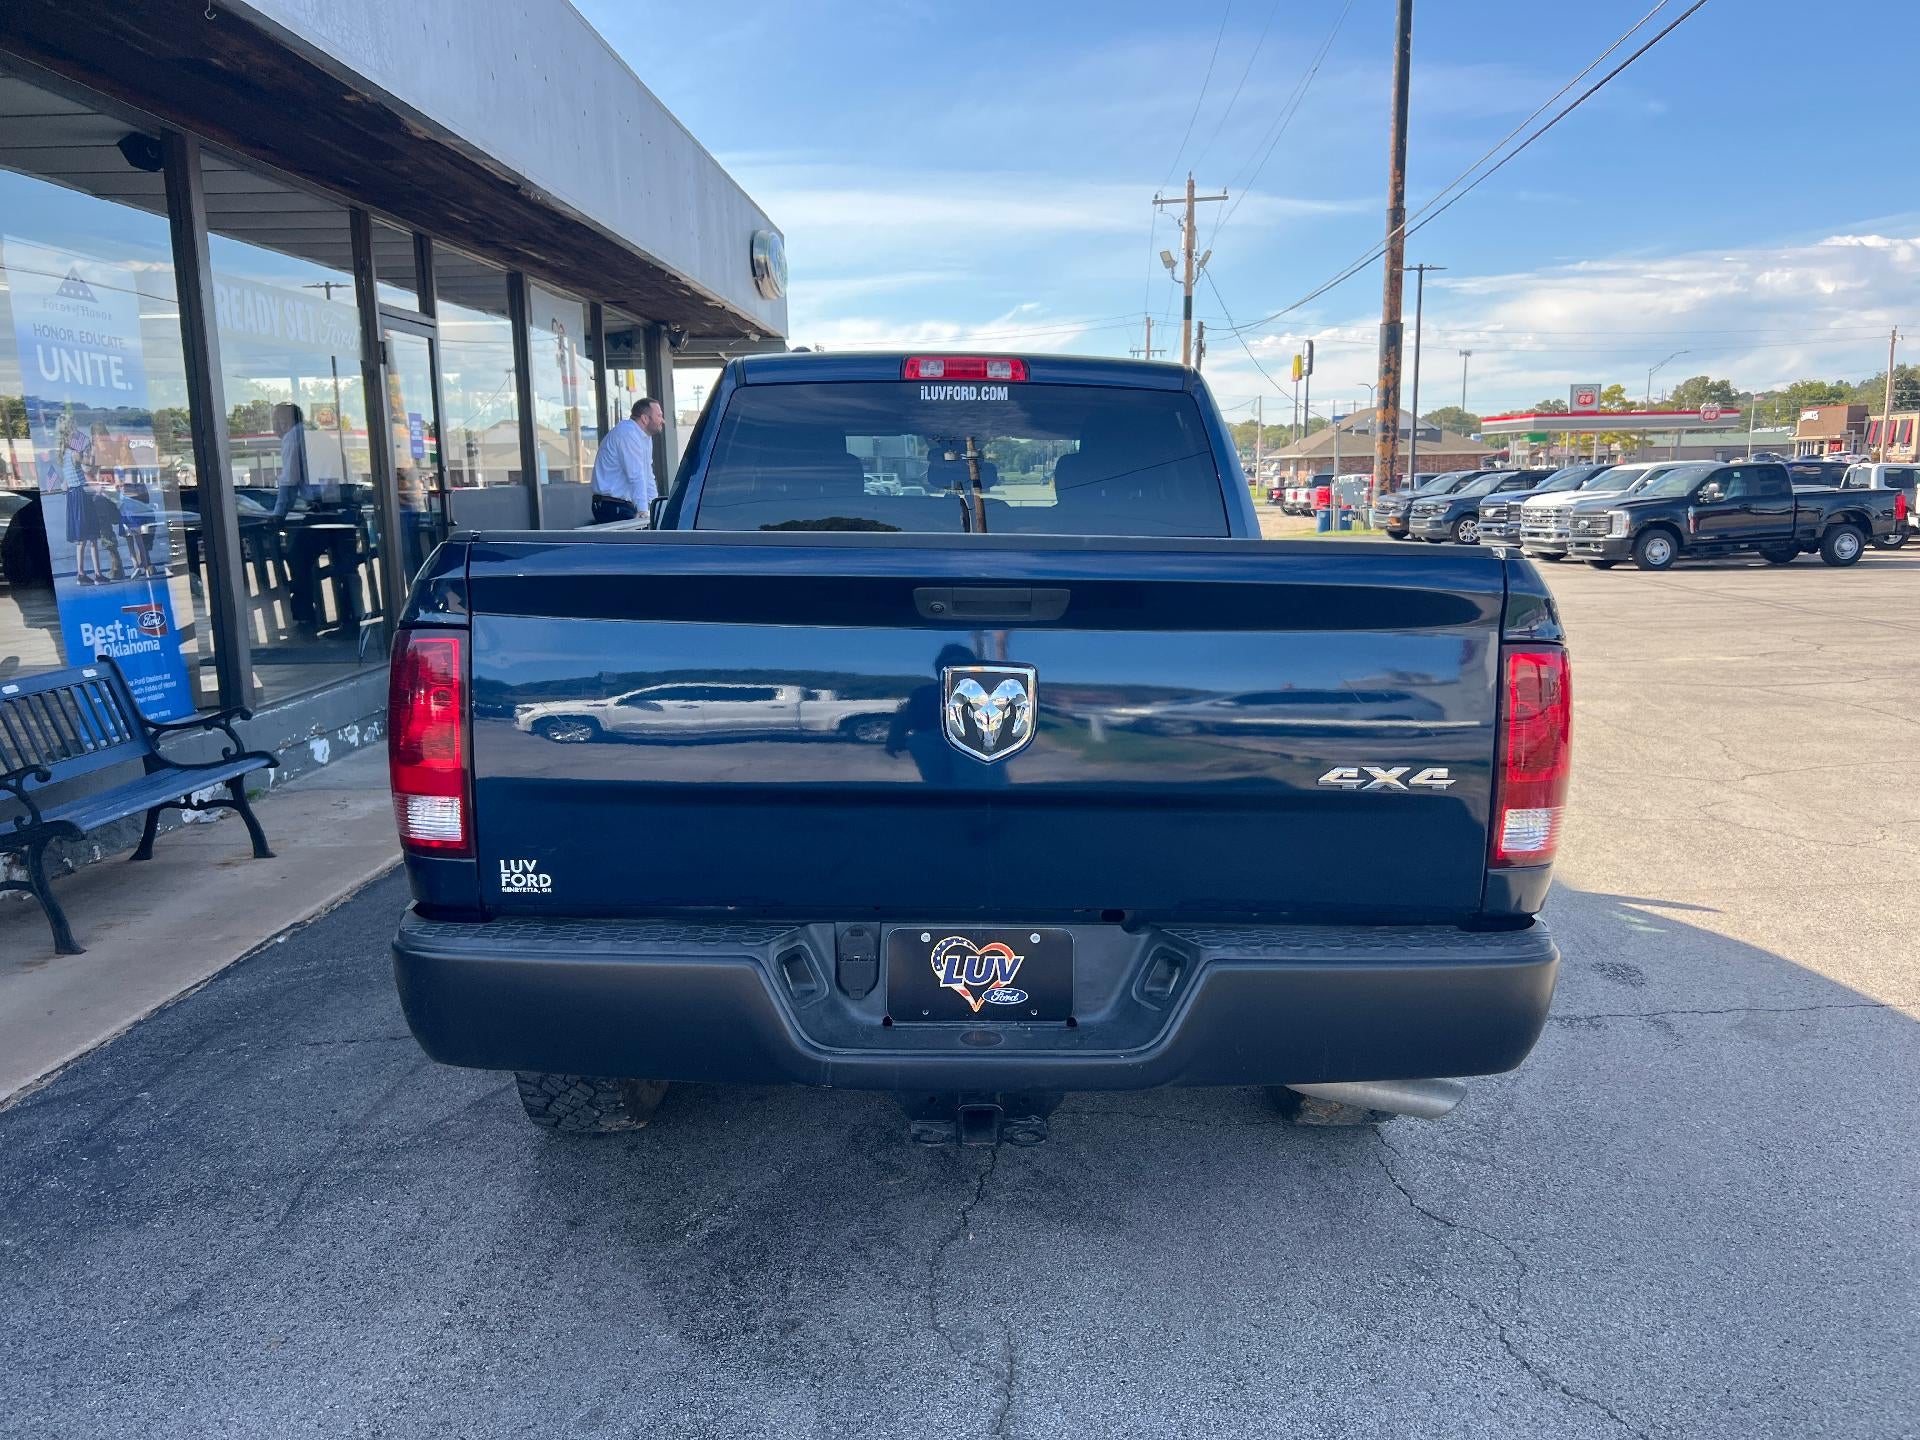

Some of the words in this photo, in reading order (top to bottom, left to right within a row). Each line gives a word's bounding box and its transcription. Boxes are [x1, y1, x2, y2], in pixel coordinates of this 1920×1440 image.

[213, 281, 280, 338] READY
[284, 299, 316, 345] SET
[36, 344, 133, 390] UNITE.
[920, 385, 1008, 401] iLUVFORD.COM
[80, 620, 125, 647] Best
[127, 624, 138, 640] in
[103, 639, 160, 657] Oklahoma
[500, 859, 537, 873] LUV
[501, 873, 552, 887] FORD
[940, 955, 1025, 988] LUV
